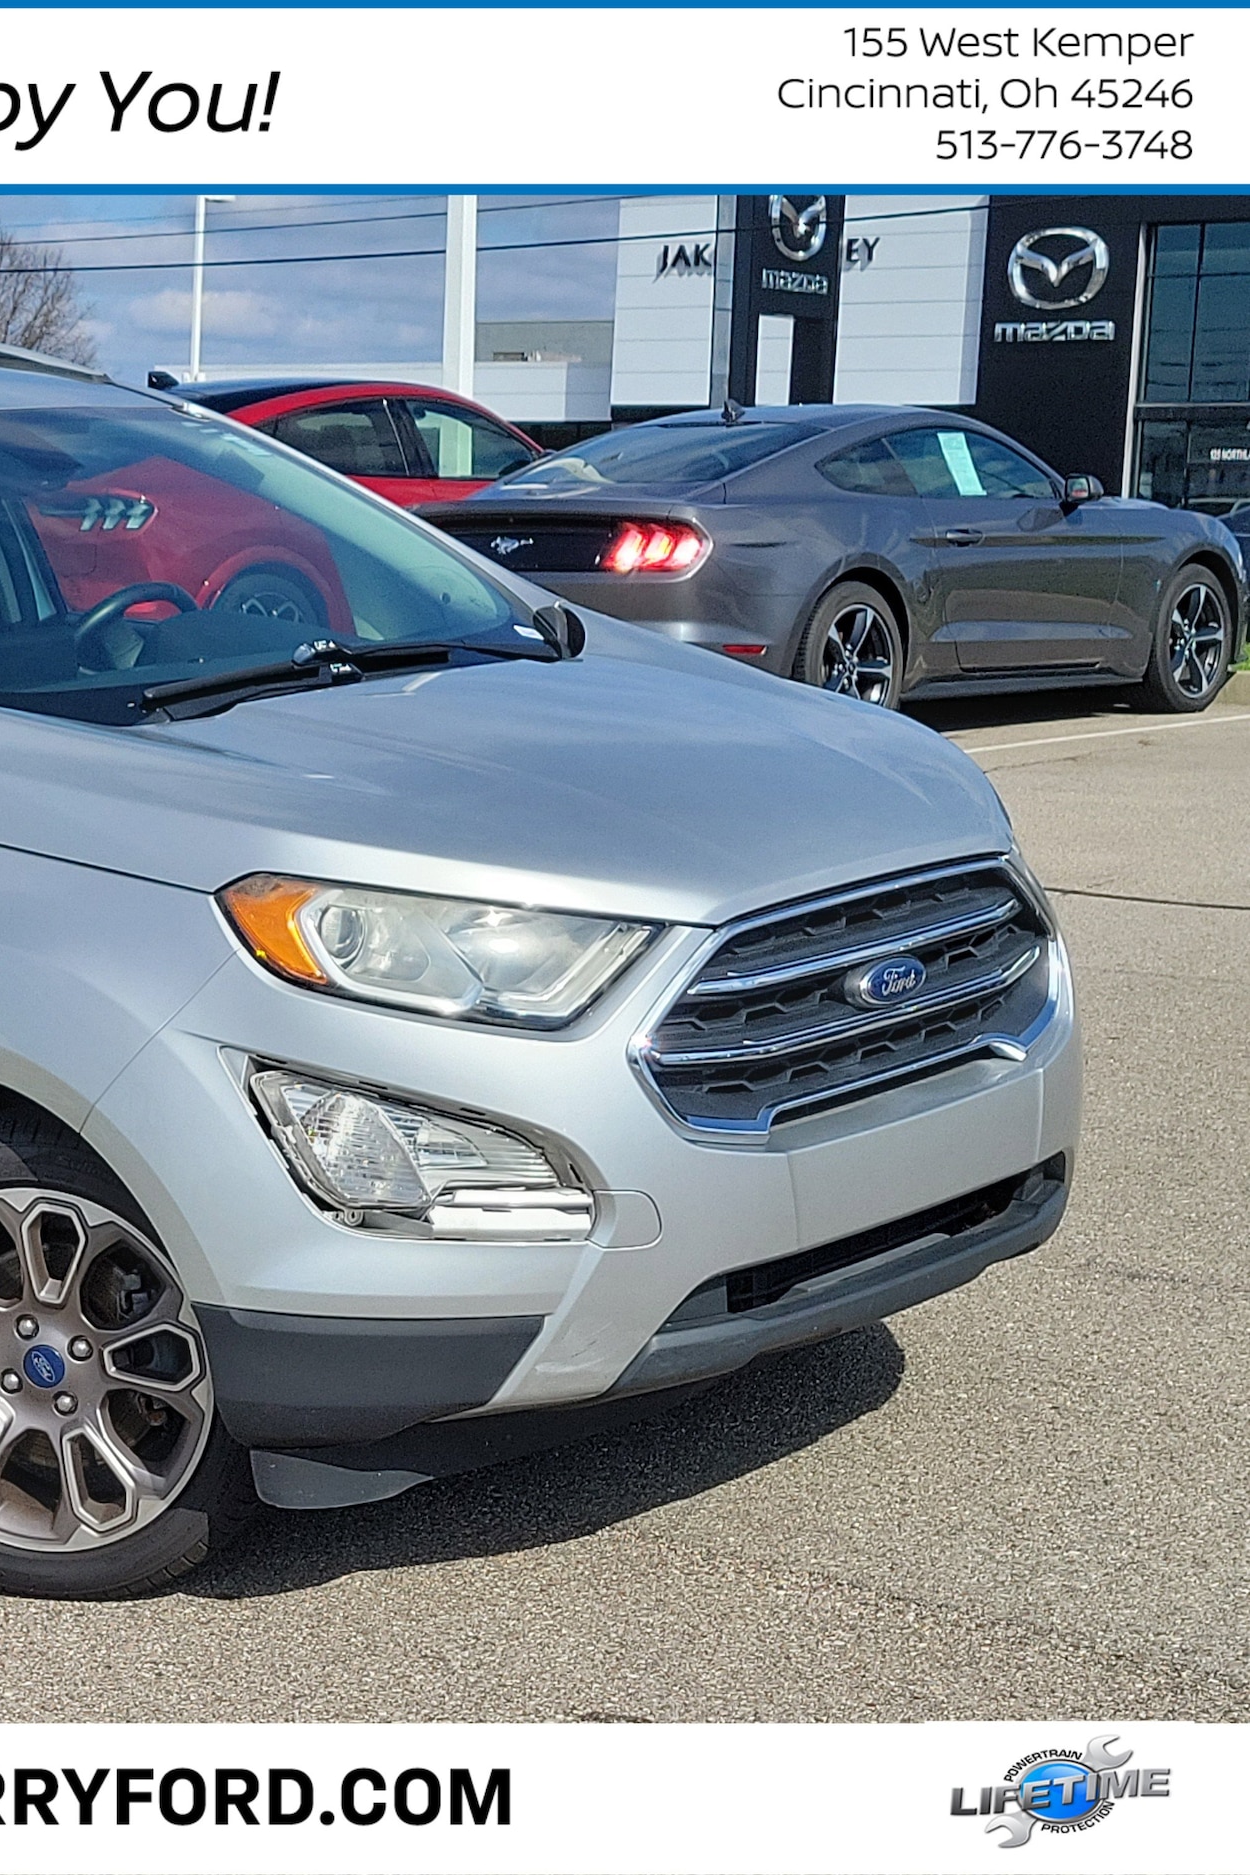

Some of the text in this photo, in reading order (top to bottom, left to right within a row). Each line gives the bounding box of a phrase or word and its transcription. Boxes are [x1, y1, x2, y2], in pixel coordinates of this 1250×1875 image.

[657, 243, 713, 273] JAK
[846, 237, 881, 263] EY
[761, 267, 829, 296] mazda
[993, 320, 1116, 342] mazda
[881, 965, 917, 997] Ford
